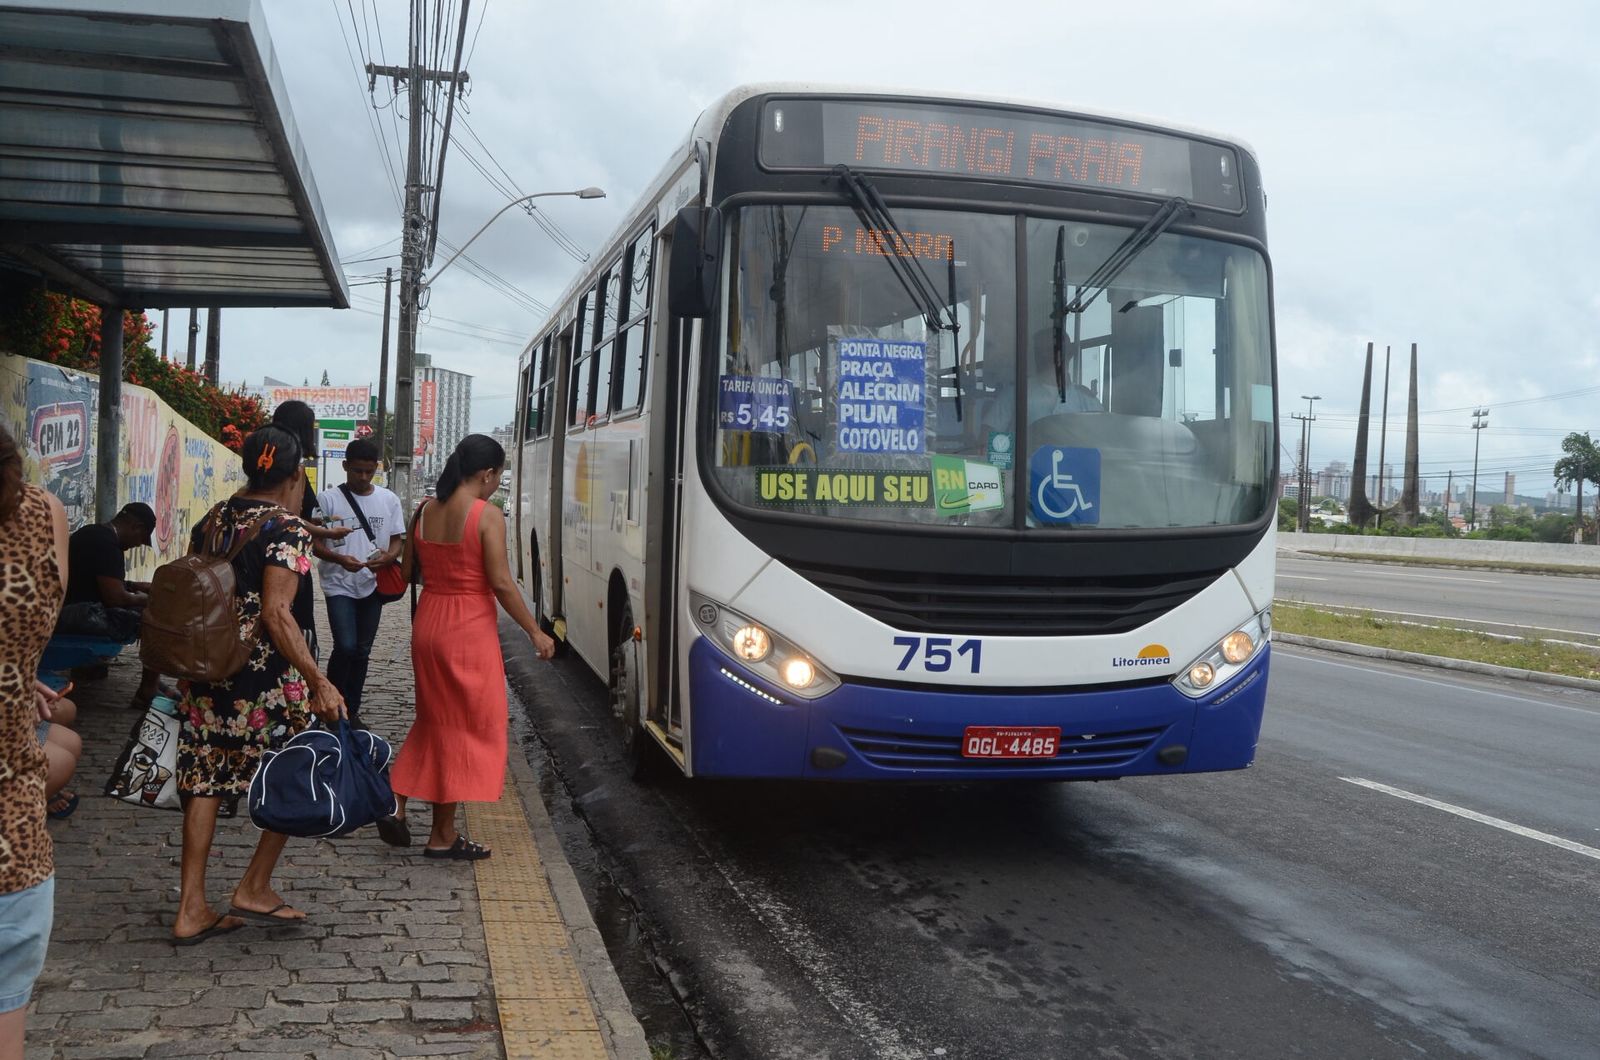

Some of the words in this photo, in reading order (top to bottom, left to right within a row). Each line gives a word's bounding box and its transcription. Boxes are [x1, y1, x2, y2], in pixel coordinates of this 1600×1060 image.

[856, 115, 1013, 174] PIRANGI
[1027, 133, 1144, 186] PRAIA
[821, 226, 847, 256] P.
[855, 228, 953, 260] NEGRA
[841, 342, 880, 357] PONTA
[883, 344, 922, 359] NEGRA
[841, 361, 893, 381] PRAÇA
[723, 380, 756, 394] TARIFA
[758, 379, 789, 395] ÚNICA
[840, 382, 919, 401] ALECRIM
[721, 411, 733, 422] R$
[738, 404, 789, 429] 5,45
[840, 404, 897, 424] PIUM
[39, 422, 64, 456] CPM
[66, 418, 80, 448] 22
[840, 428, 918, 450] COTOVELO
[760, 473, 808, 500] USE
[815, 475, 875, 503] AQUI
[883, 475, 928, 502] SEU
[937, 469, 964, 490] RN
[968, 481, 998, 490] CARD
[893, 636, 982, 674] 751
[1112, 656, 1170, 667] Litorânea
